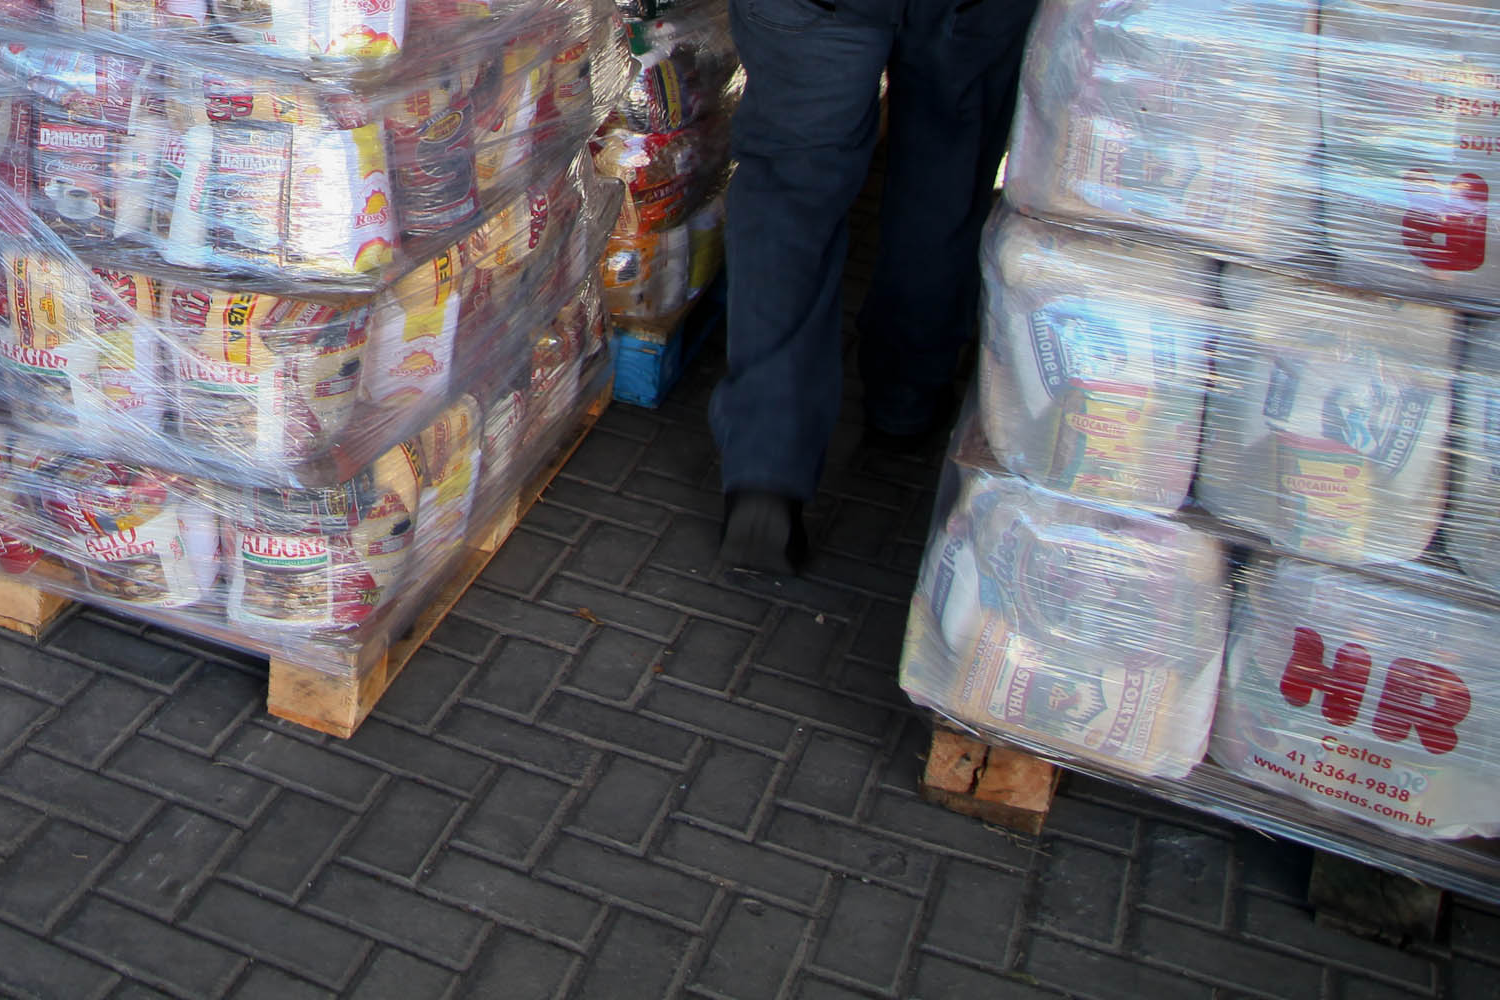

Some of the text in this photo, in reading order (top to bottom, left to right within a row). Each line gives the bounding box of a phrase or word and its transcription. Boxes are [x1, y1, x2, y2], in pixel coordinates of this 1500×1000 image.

[40, 127, 105, 150] Damasco
[1279, 626, 1472, 755] HR
[1286, 750, 1411, 803] 41 3364-9838
[1320, 735, 1393, 770] Cestas
[1253, 754, 1437, 829] www.hrcestas.com.br
